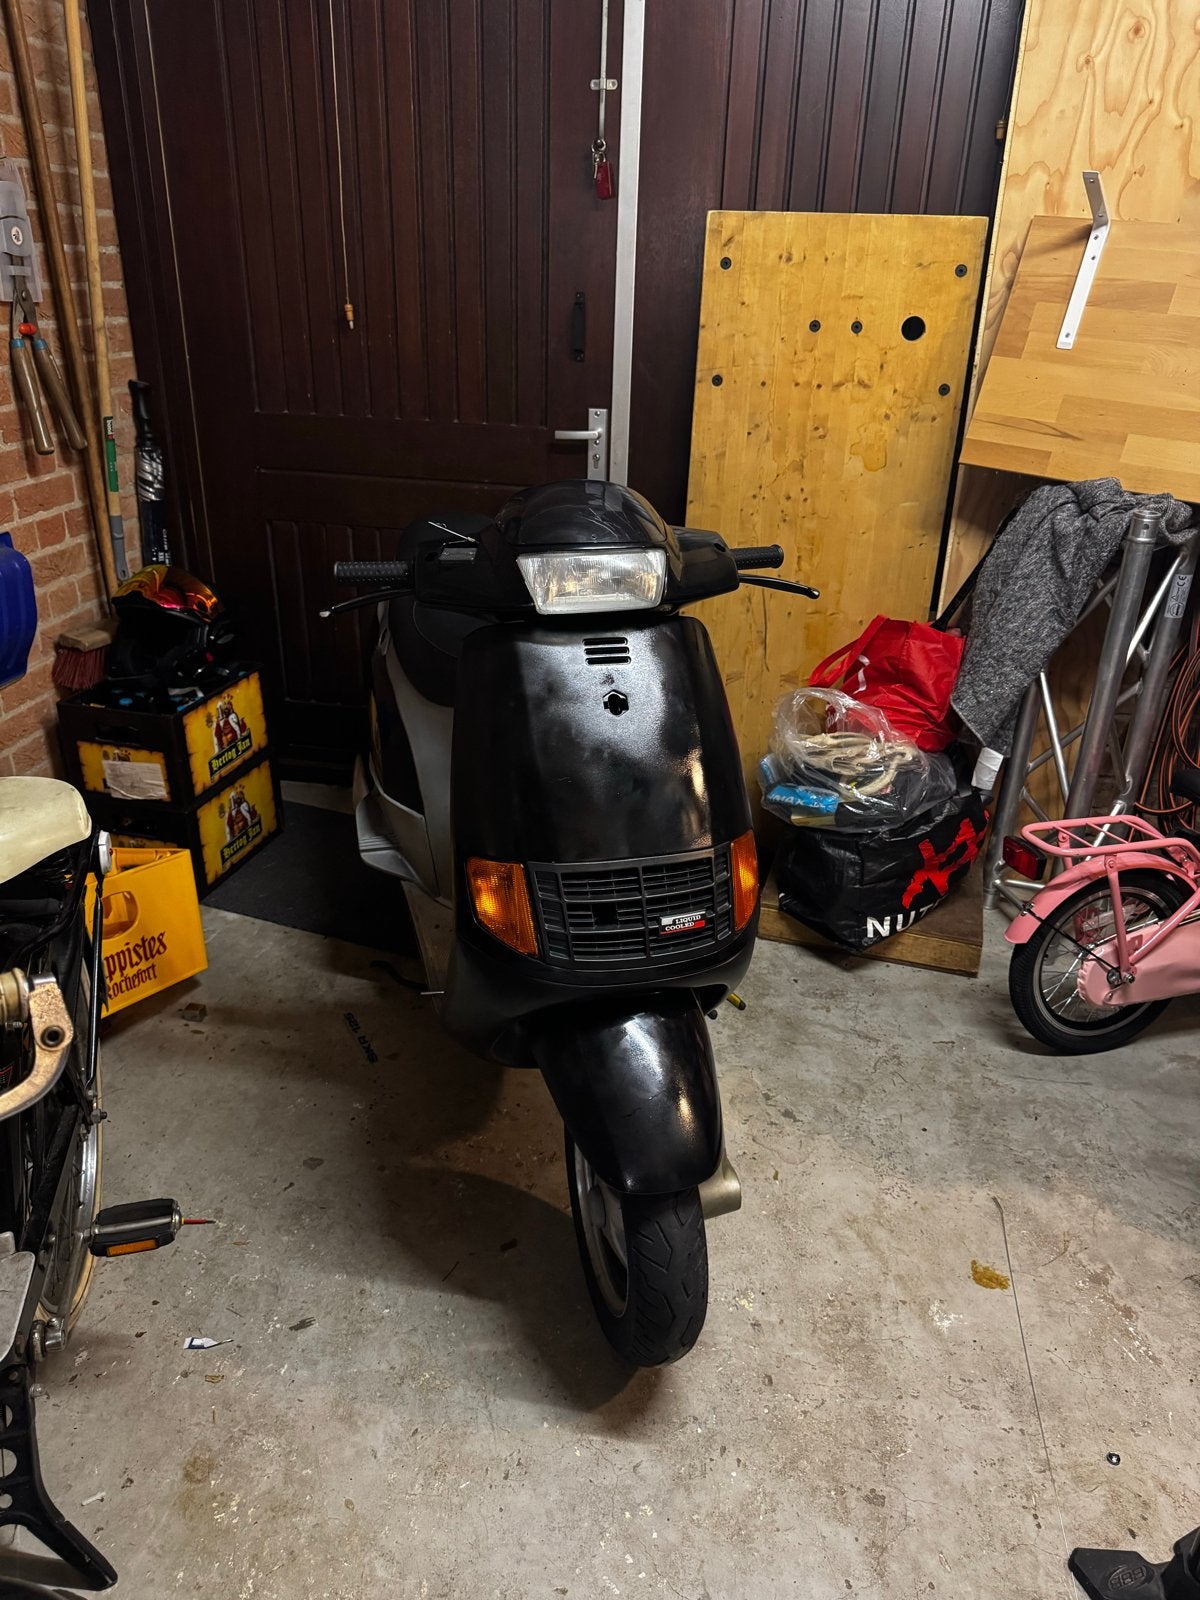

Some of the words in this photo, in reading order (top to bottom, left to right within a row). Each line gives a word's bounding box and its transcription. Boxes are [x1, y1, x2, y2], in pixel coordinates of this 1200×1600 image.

[211, 748, 238, 772] Hertog
[237, 738, 251, 756] Jan
[222, 834, 248, 860] Hertog
[247, 823, 261, 841] Jan
[665, 921, 695, 931] COOLED
[675, 914, 702, 925] LIQUID
[104, 930, 168, 983] ppistes
